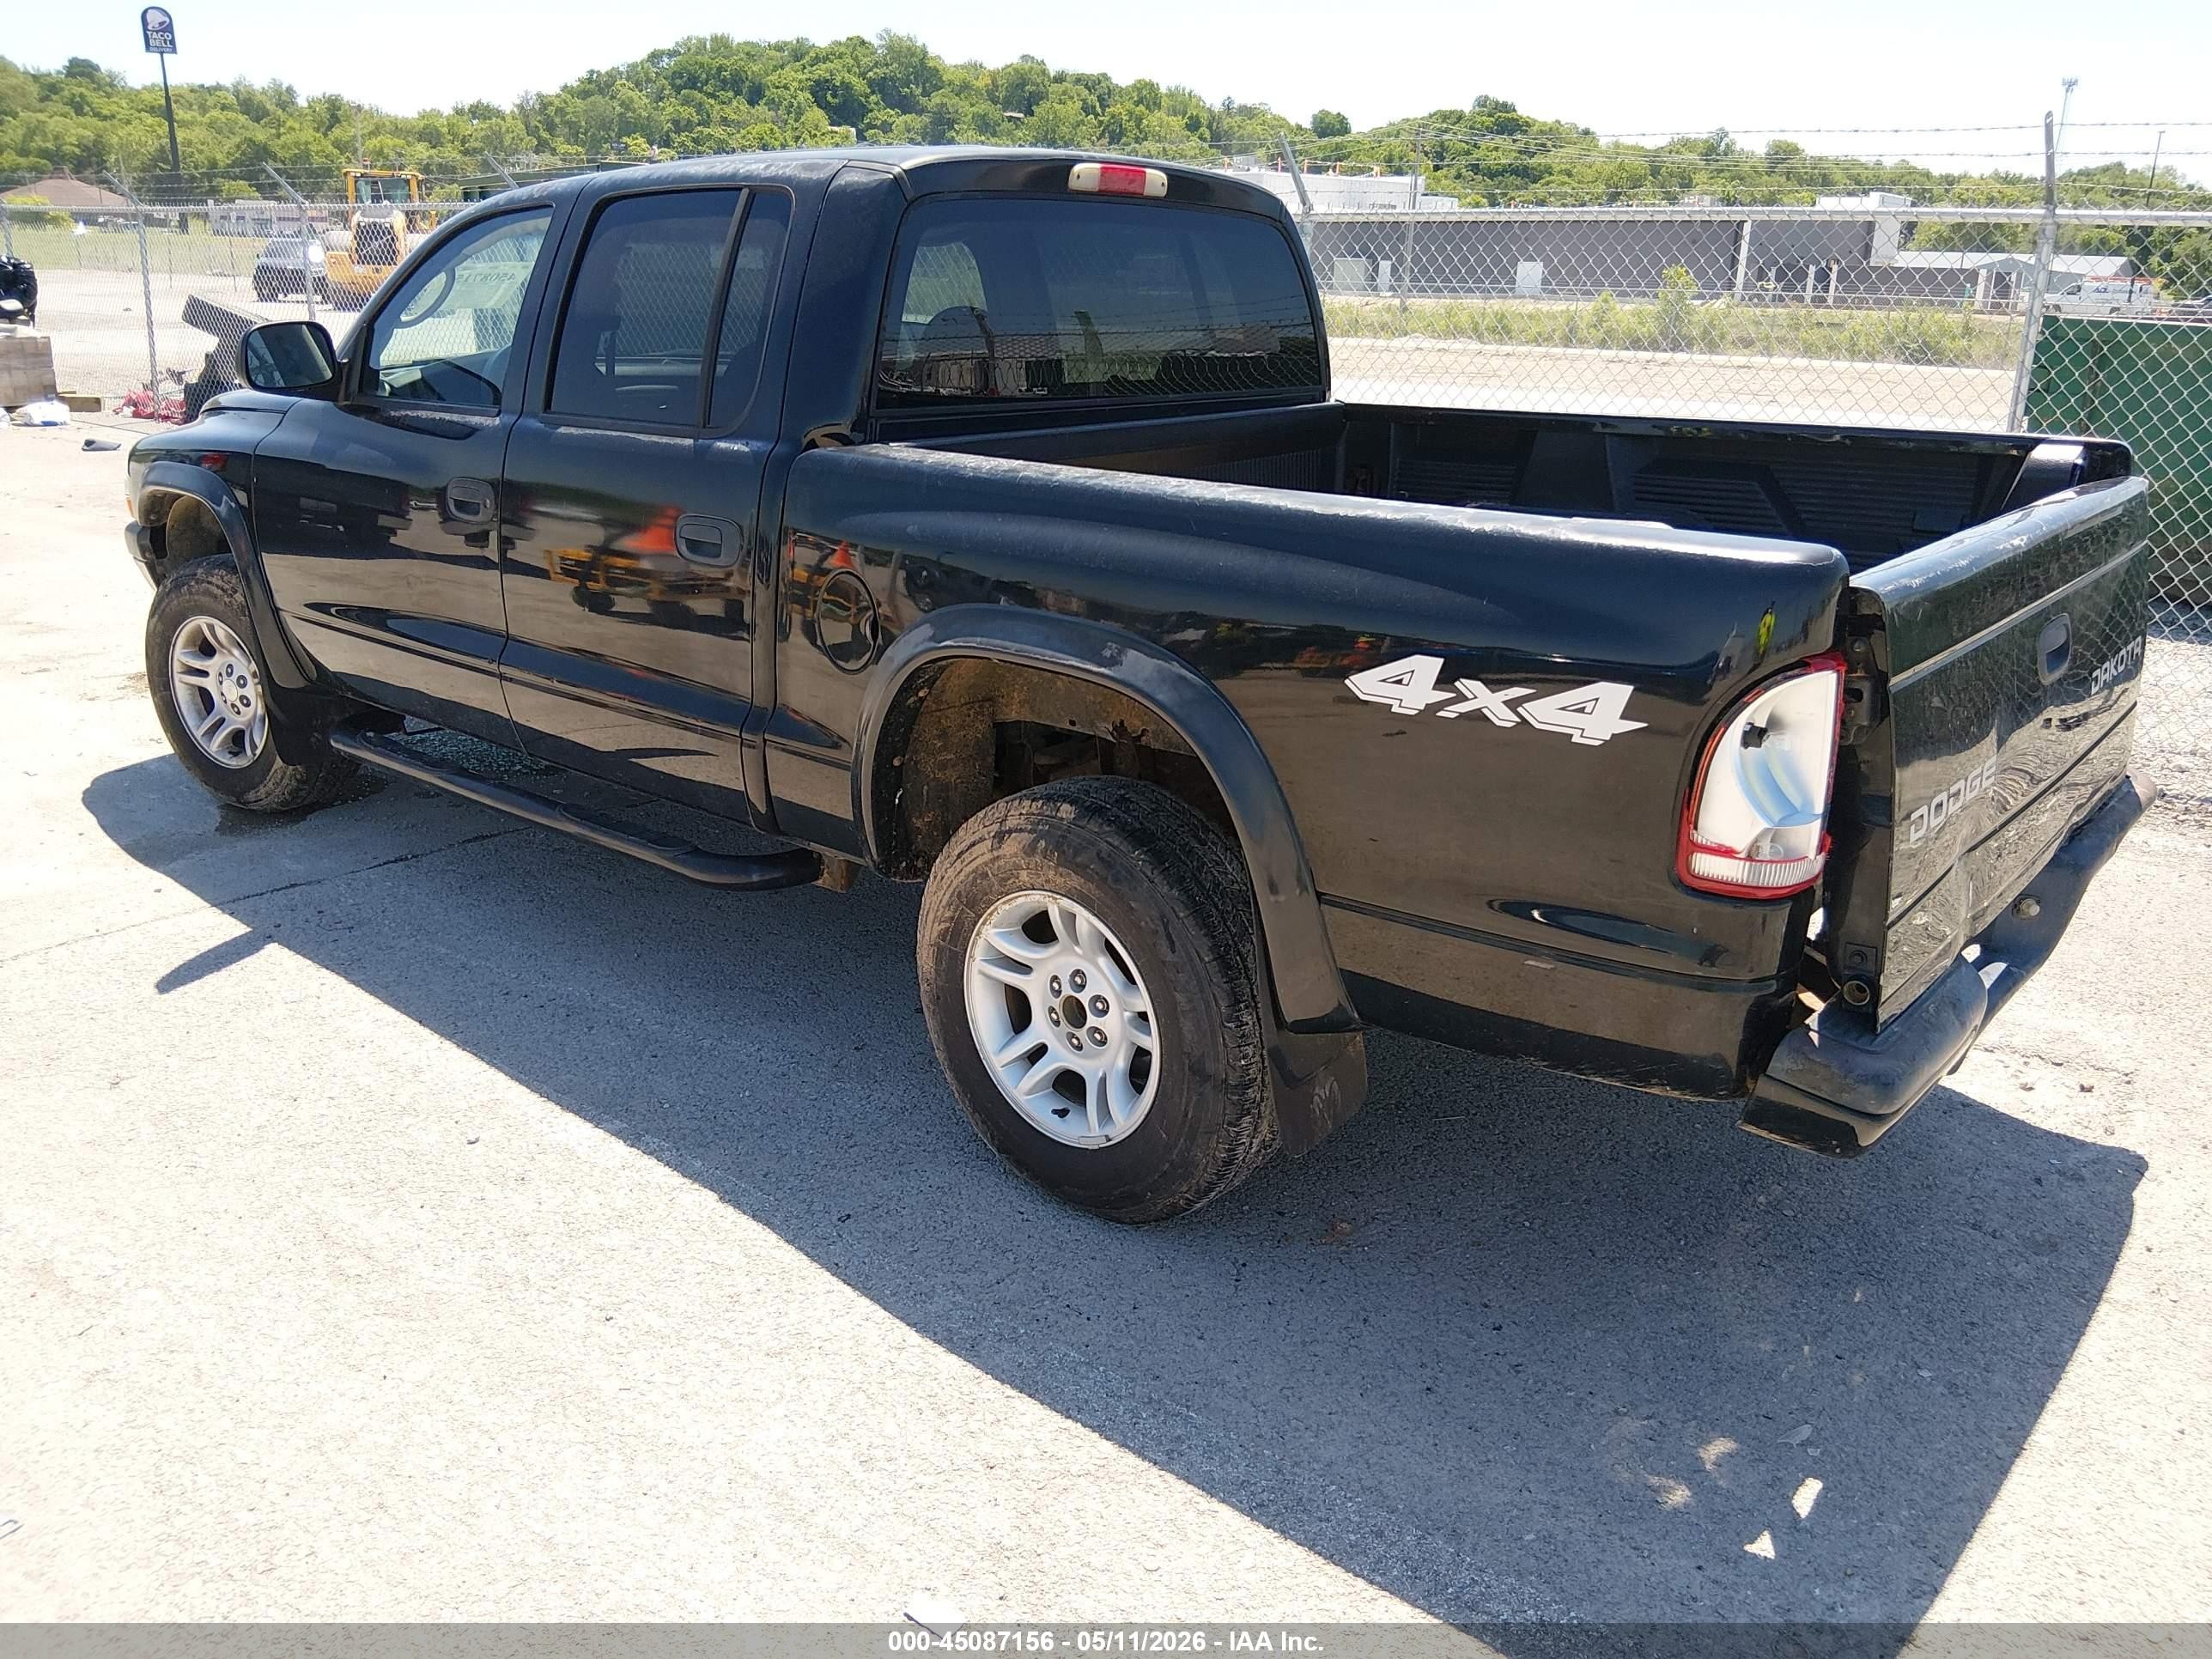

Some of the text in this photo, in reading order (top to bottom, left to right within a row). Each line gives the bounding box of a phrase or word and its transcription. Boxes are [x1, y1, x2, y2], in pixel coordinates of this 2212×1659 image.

[146, 30, 172, 40] TACO
[149, 39, 173, 47] BELL
[2090, 635, 2142, 696] DAKOTA
[1344, 654, 1649, 746] 4x4
[1909, 756, 1997, 845] DODGE
